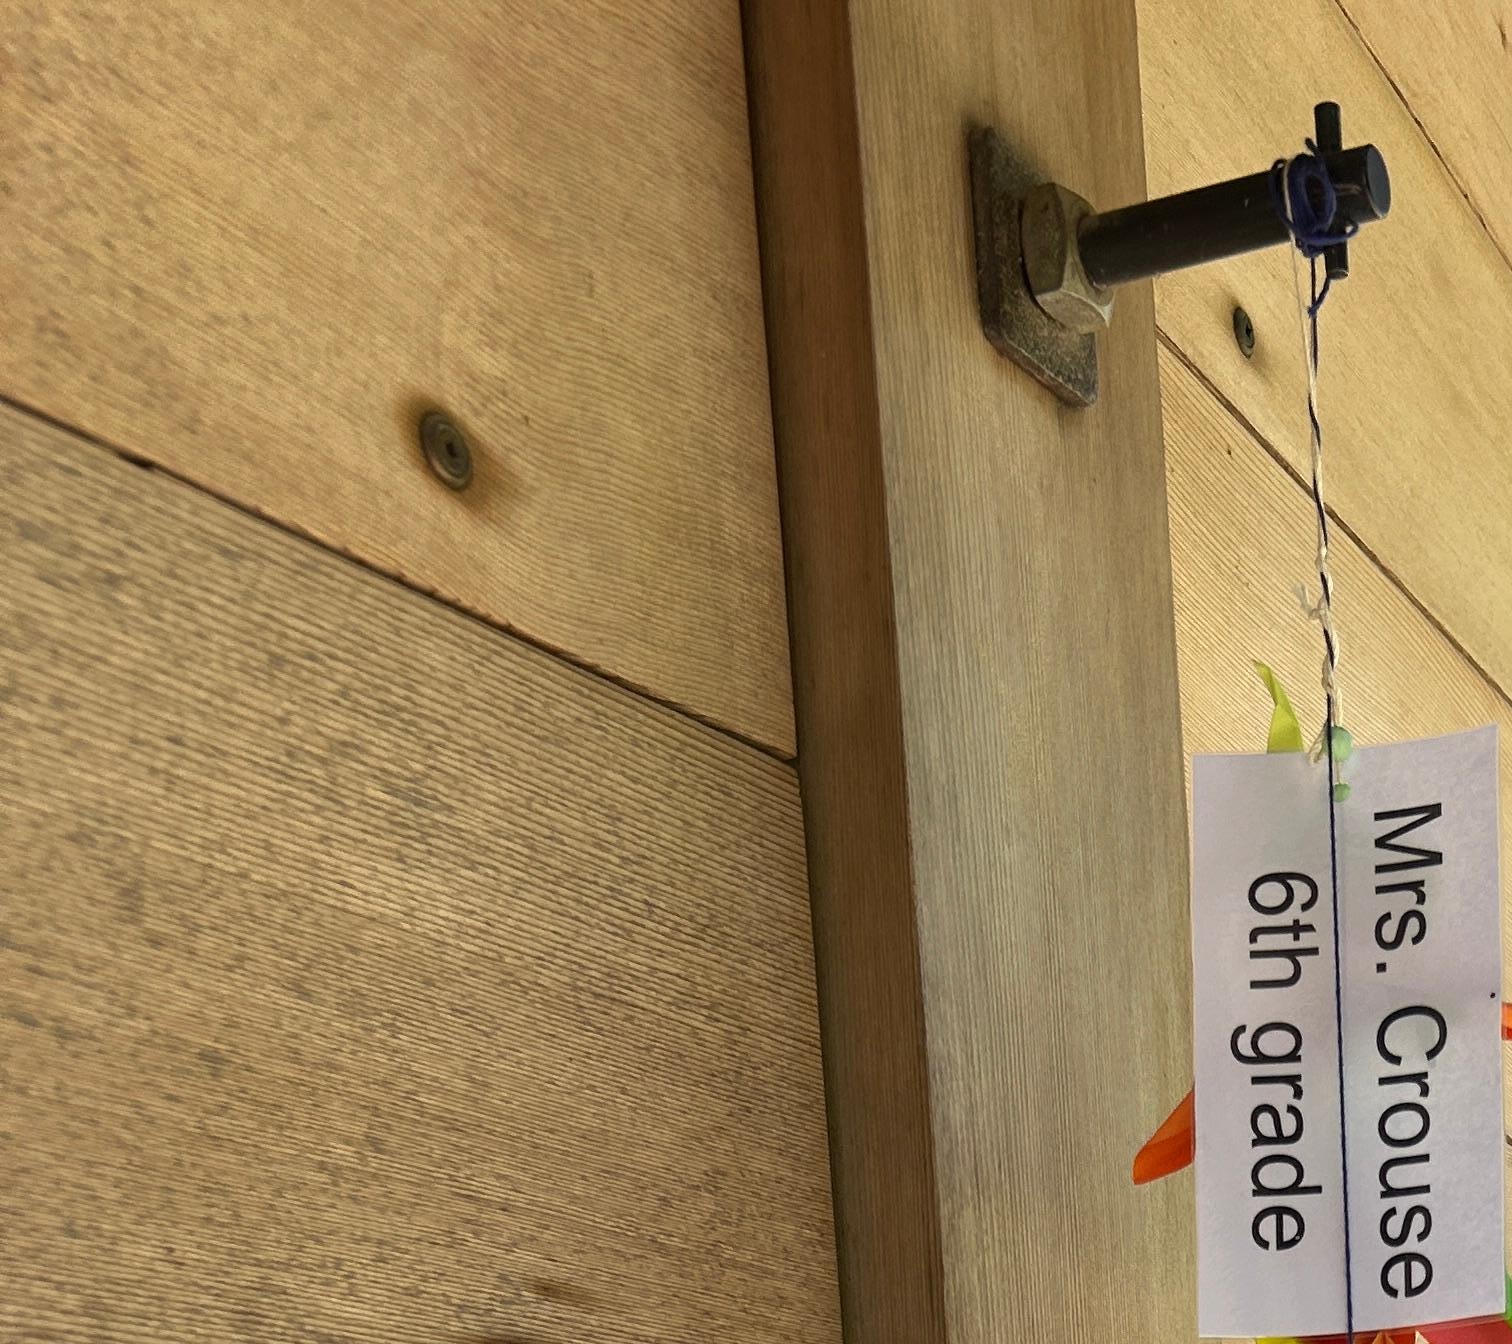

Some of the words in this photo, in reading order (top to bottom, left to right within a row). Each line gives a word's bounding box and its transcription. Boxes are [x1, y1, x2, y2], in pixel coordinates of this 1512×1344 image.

[1247, 871, 1320, 990] 6th
[1374, 801, 1443, 974] Mrs.
[1230, 1021, 1323, 1252] grade
[1375, 1004, 1448, 1301] Crouse
